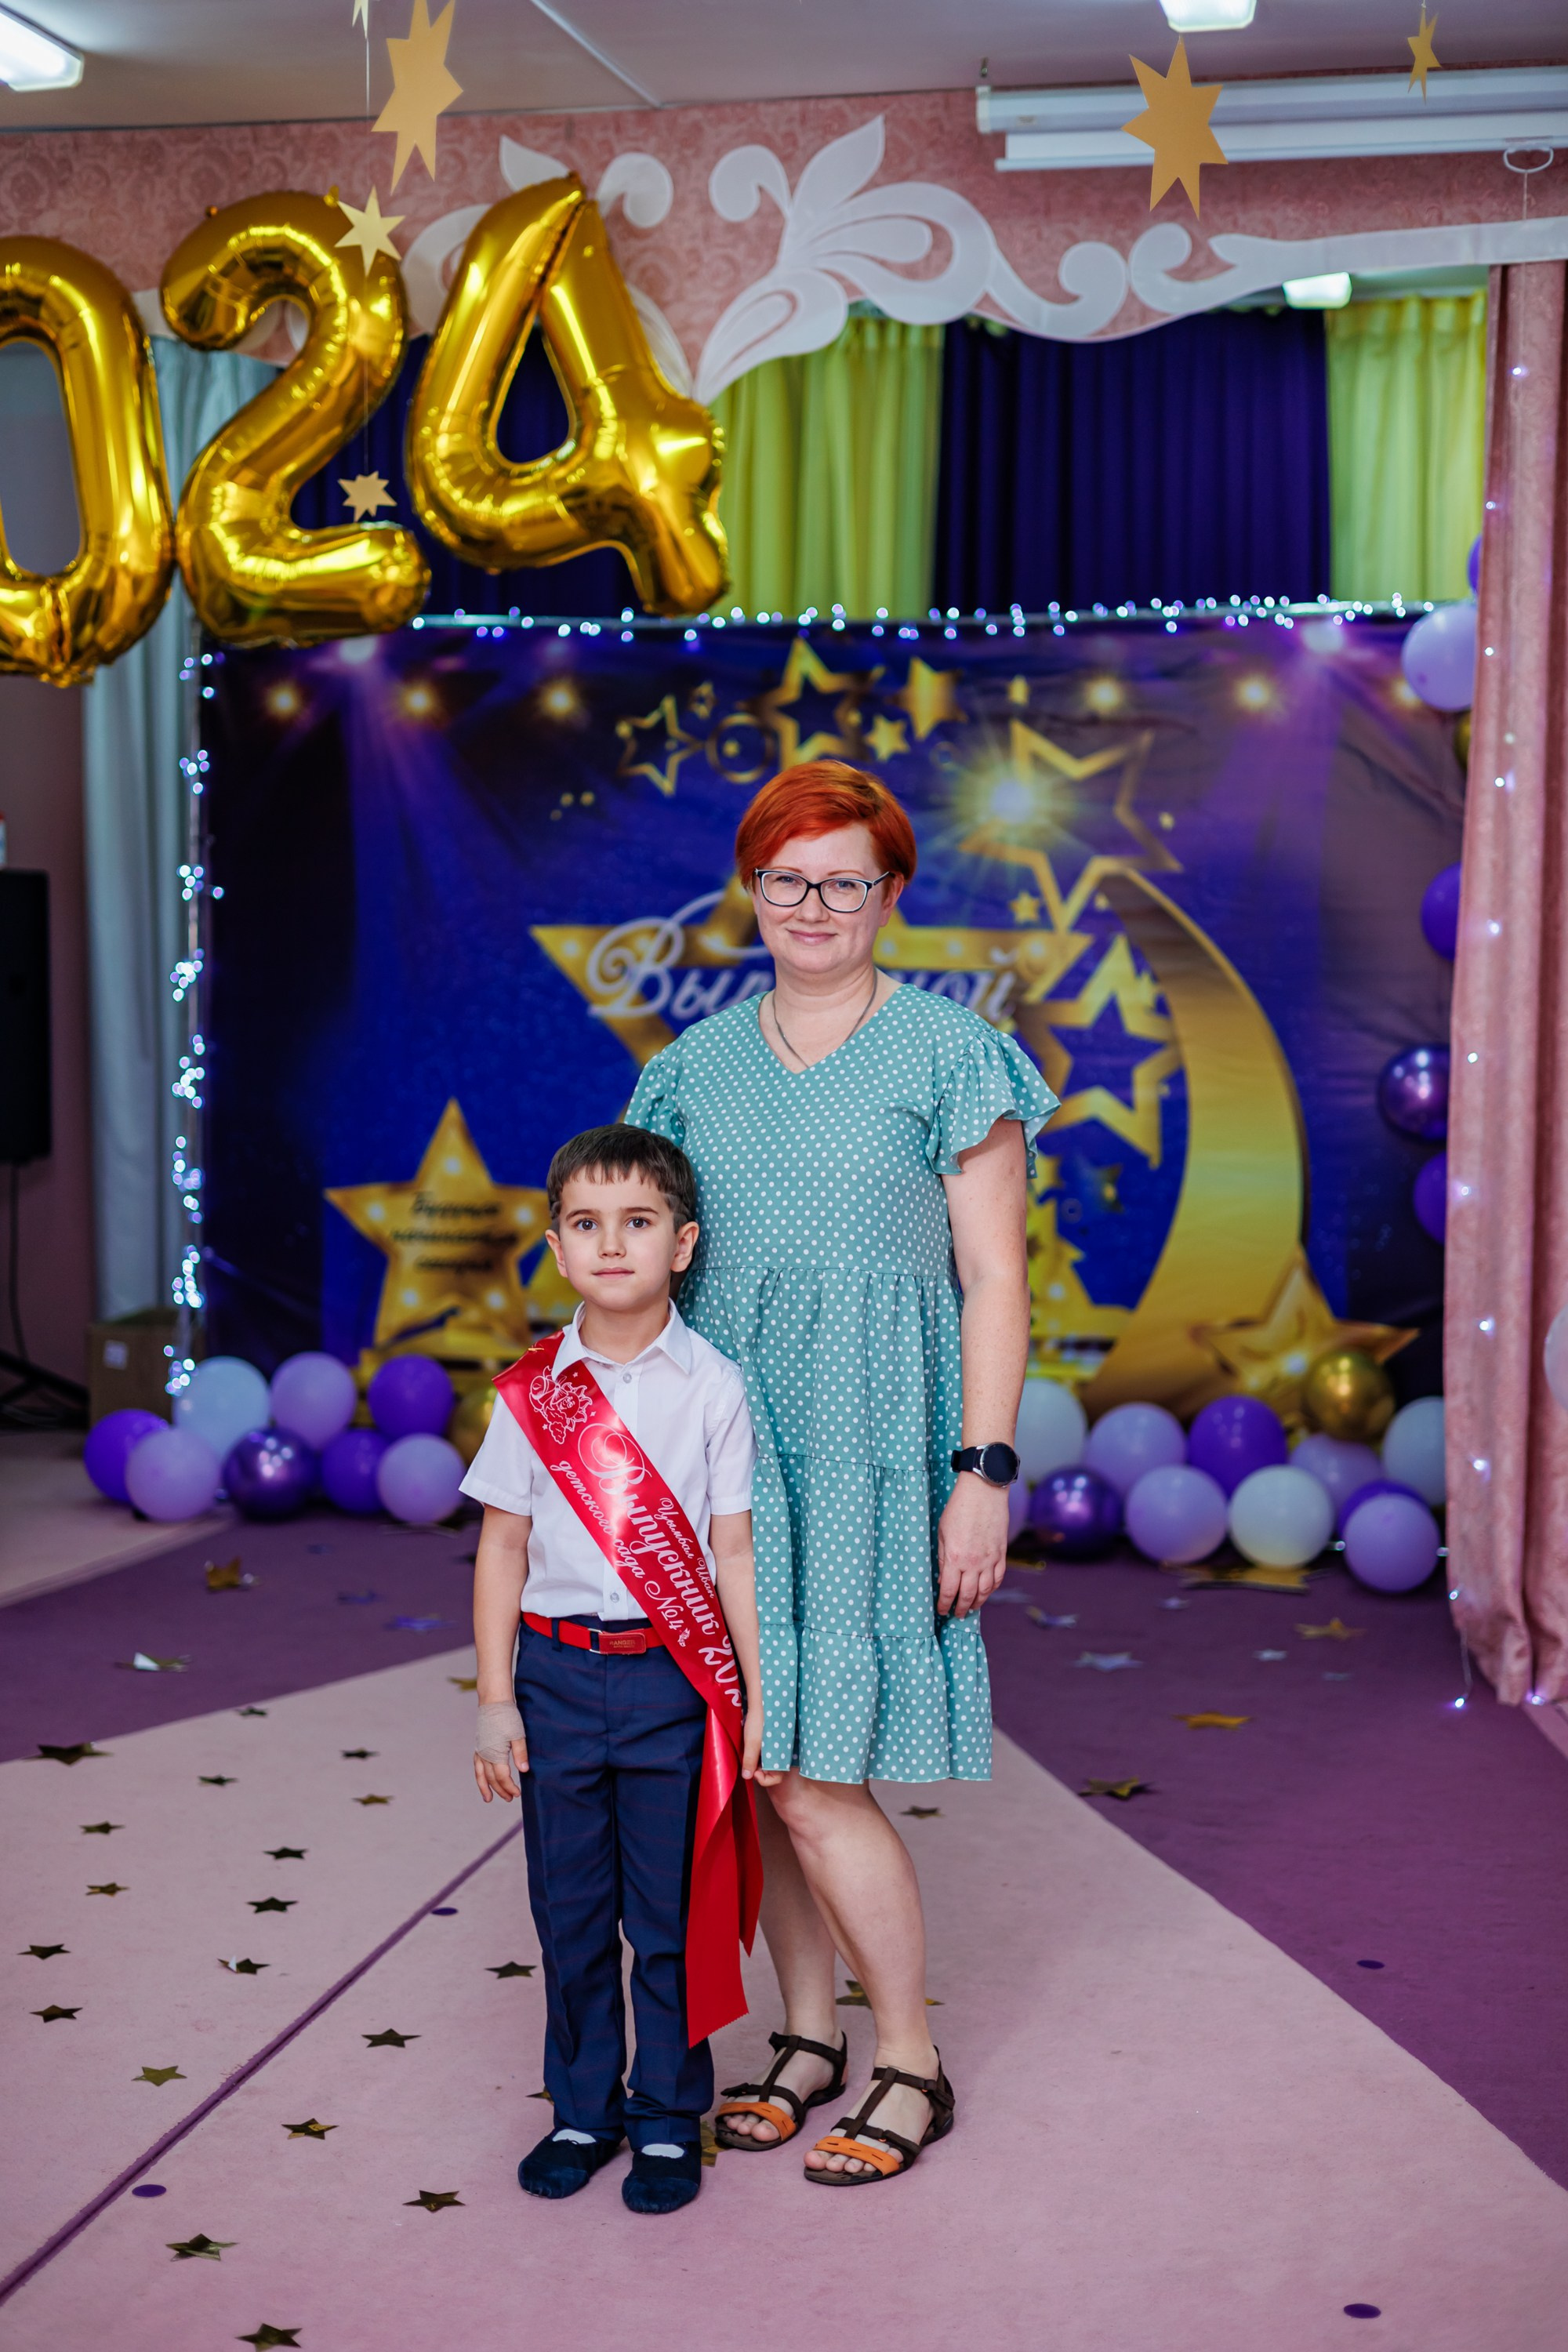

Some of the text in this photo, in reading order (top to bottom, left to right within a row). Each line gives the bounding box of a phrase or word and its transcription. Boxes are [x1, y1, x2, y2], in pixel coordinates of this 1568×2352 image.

[550, 1460, 615, 1536] детского
[613, 1538, 645, 1579] сада
[578, 1423, 742, 1709] Выпускник 202
[695, 1557, 715, 1599] Иван
